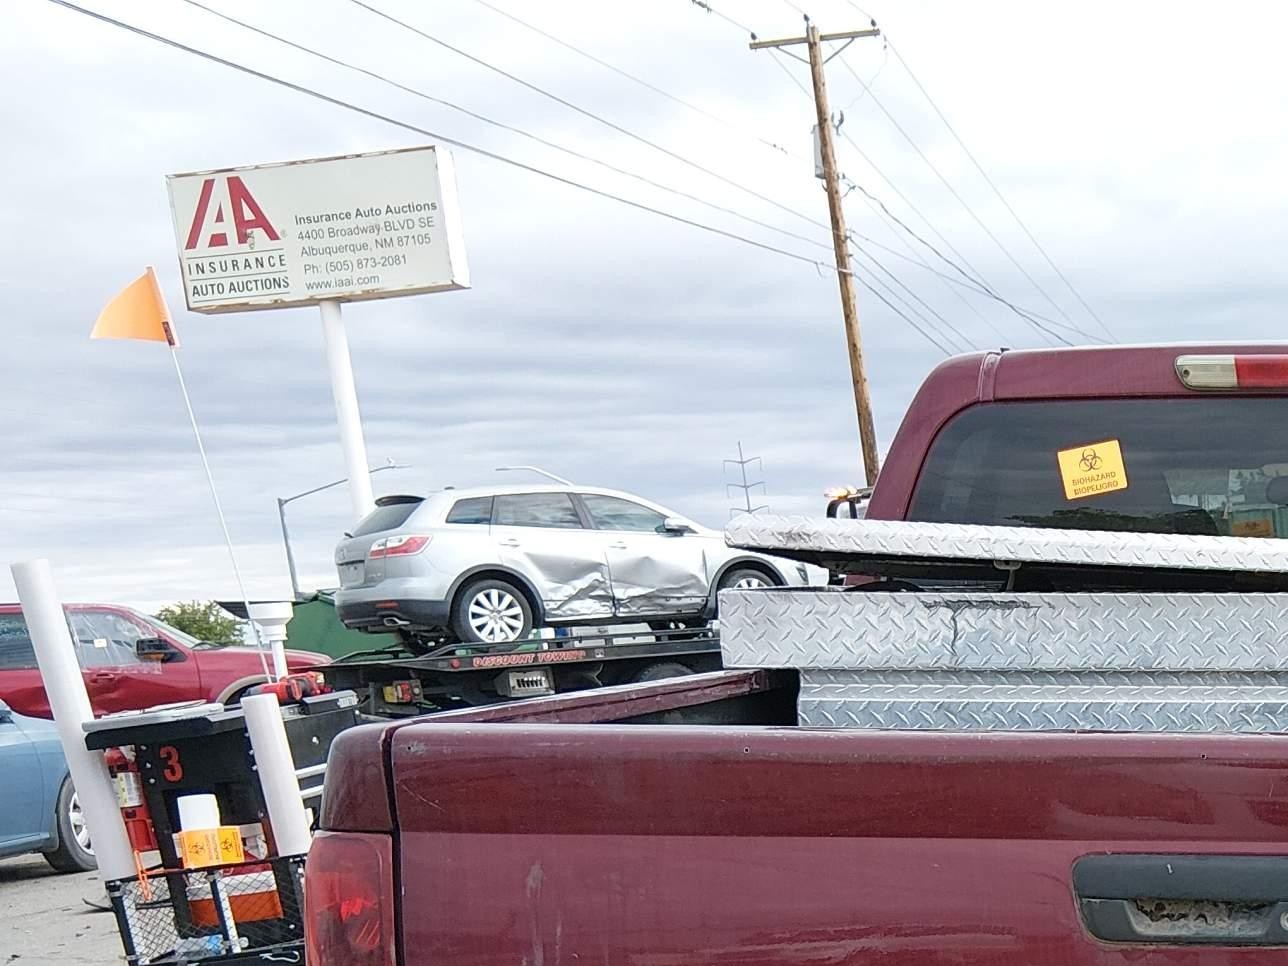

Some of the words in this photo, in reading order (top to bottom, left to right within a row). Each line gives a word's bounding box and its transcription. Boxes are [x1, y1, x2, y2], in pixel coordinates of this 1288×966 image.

[295, 210, 351, 225] Insurance
[355, 207, 382, 219] Auto
[385, 201, 437, 215] Auctions
[297, 229, 325, 240] 4400
[328, 223, 381, 239] Broadway
[384, 218, 415, 232] BLVD
[418, 216, 435, 228] SE
[301, 241, 372, 257] Albuquerque,
[375, 237, 394, 249] NM
[397, 233, 431, 247] 87105
[188, 254, 286, 276] INSURANCE
[304, 263, 322, 275] Ph:
[325, 259, 353, 273] (505)
[357, 254, 407, 269] 873-2081
[192, 283, 225, 297] AUTO
[229, 277, 289, 293] AUCTIONS
[306, 275, 380, 290] www.iaai.com
[1072, 472, 1116, 486] BIOHAZARD
[1074, 480, 1118, 496] BIOPELIGRO
[473, 653, 535, 667] DISCOUNT
[160, 745, 183, 783] 3
